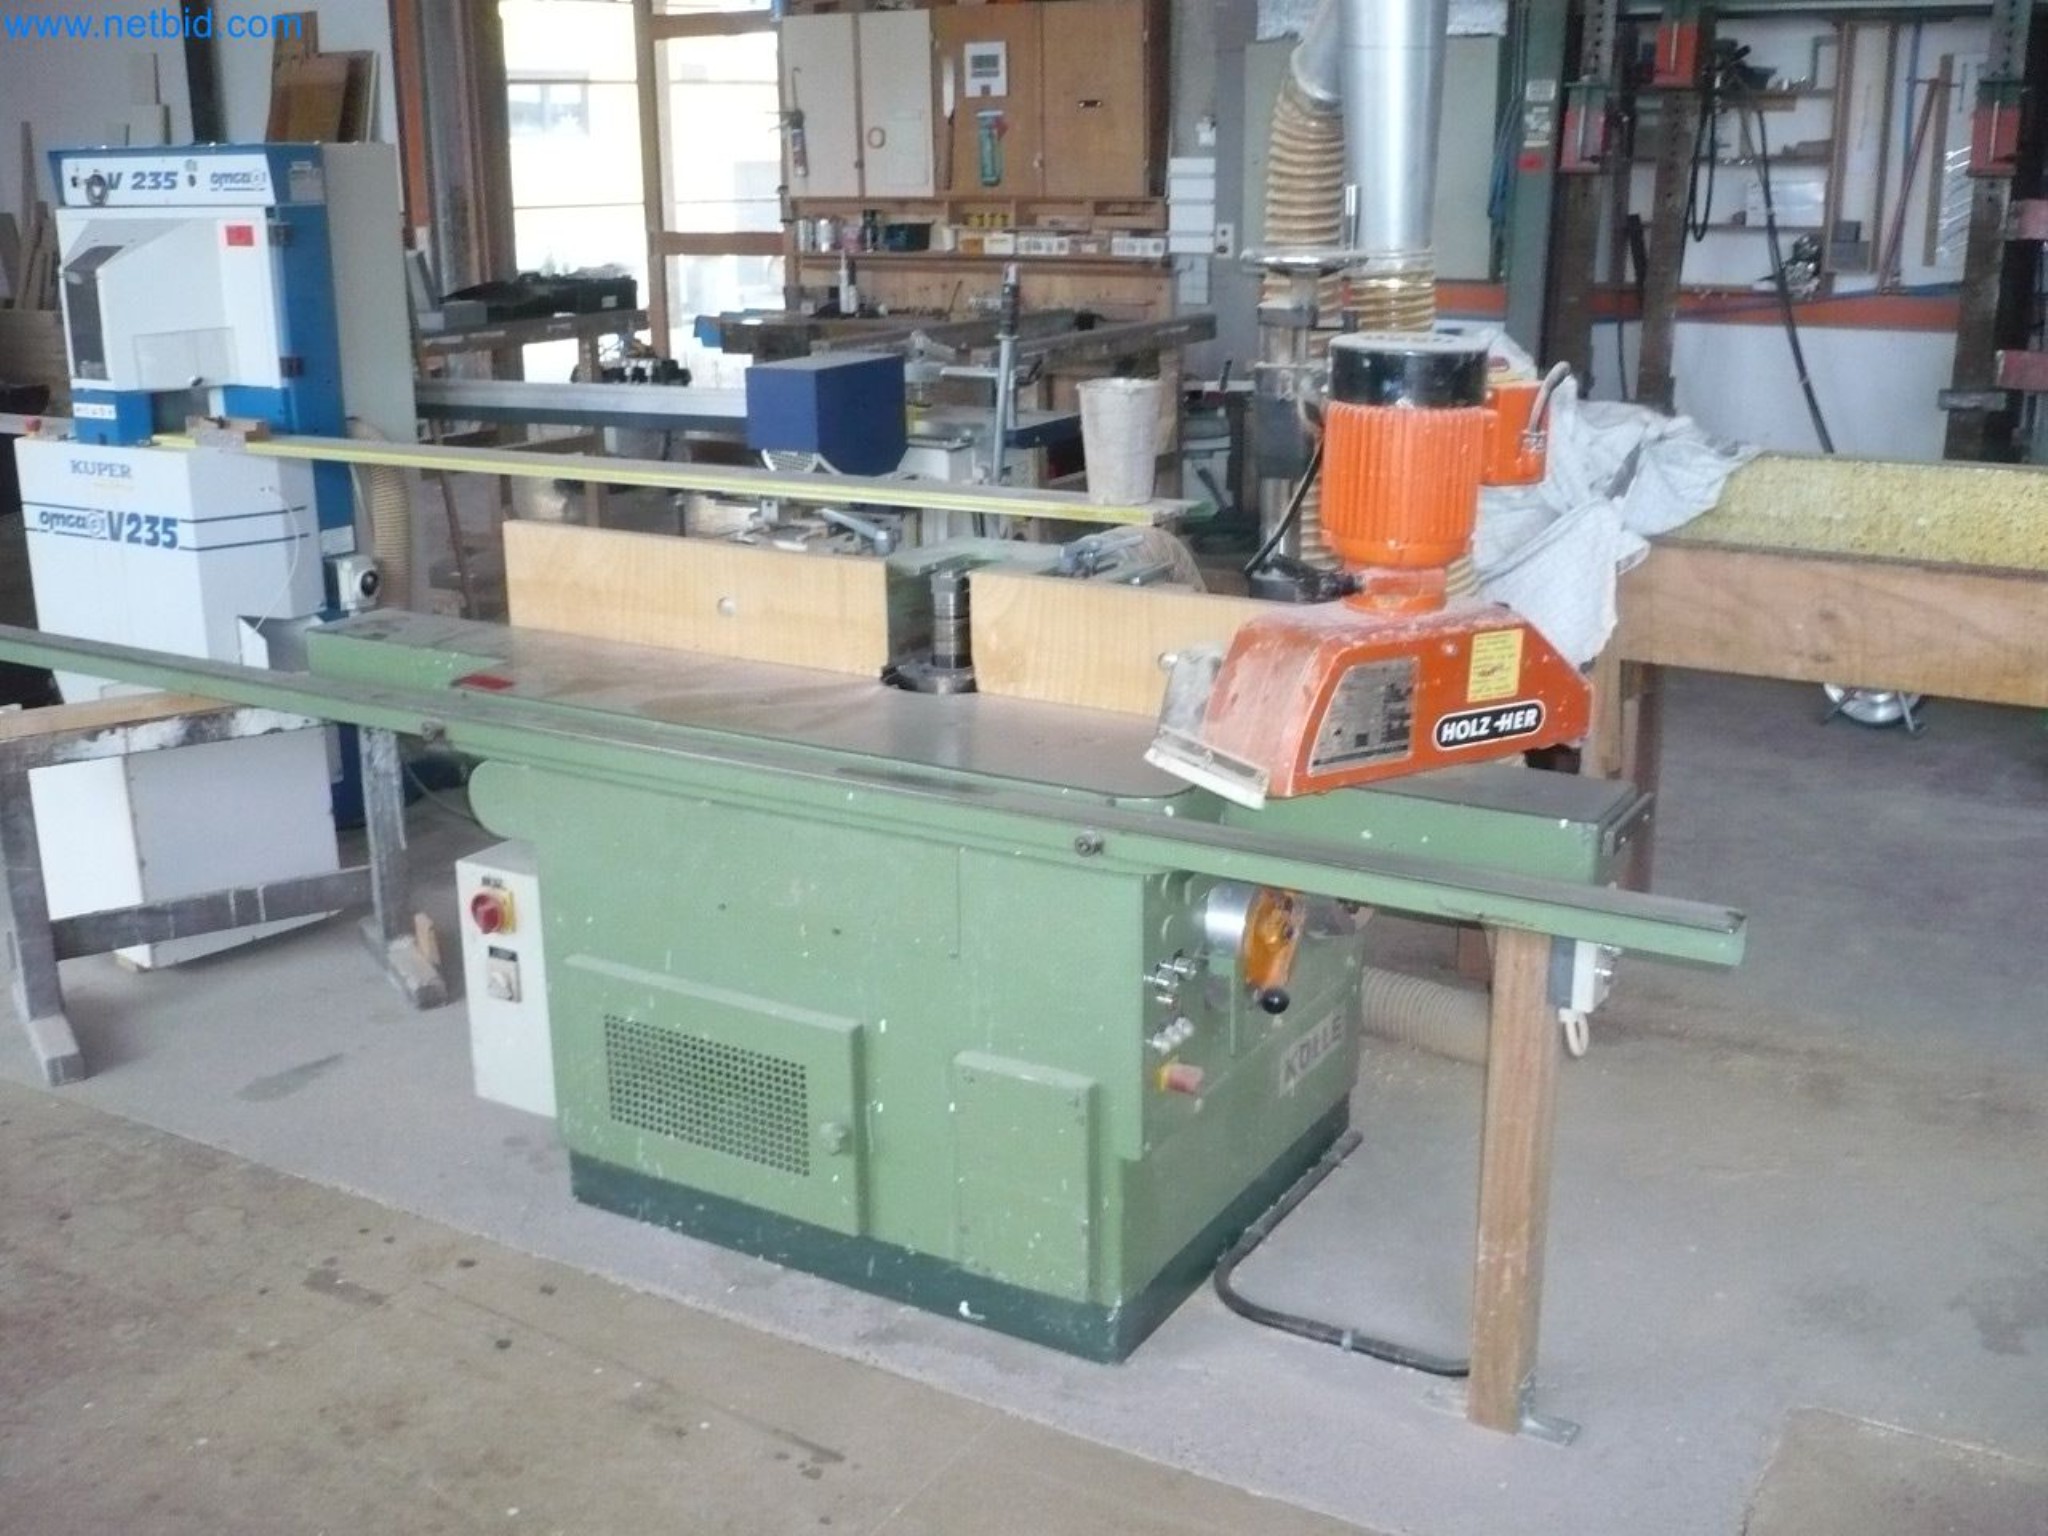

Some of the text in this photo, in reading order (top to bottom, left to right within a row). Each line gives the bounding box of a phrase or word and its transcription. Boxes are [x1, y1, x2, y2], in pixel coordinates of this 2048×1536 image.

[132, 172, 178, 189] 235
[71, 460, 132, 478] KUPER
[108, 510, 179, 549] V235
[1441, 708, 1537, 742] HOLZ-HER
